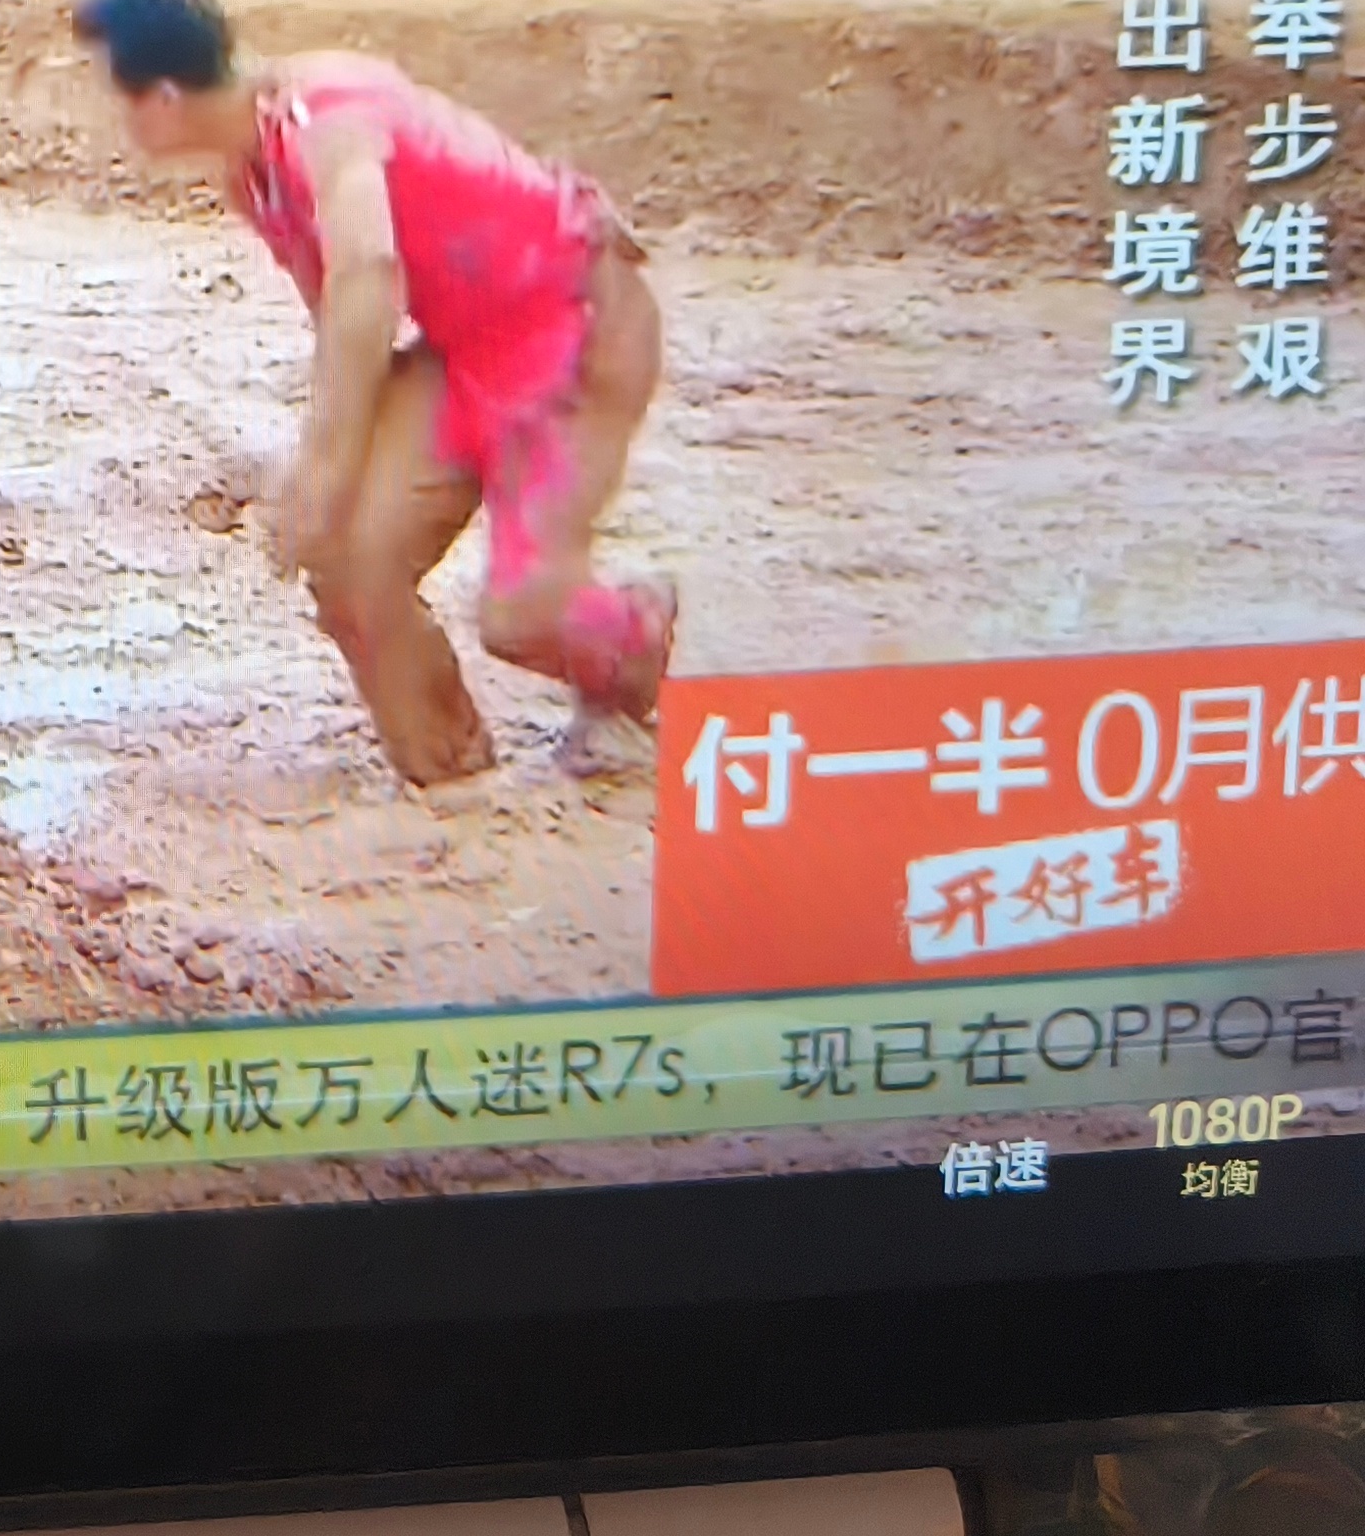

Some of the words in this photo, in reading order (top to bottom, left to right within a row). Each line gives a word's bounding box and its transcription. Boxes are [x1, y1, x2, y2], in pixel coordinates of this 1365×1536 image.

[1149, 1095, 1304, 1149] 1080P
[940, 1136, 1050, 1199] 倍速
[1180, 1156, 1260, 1200] 均衡
